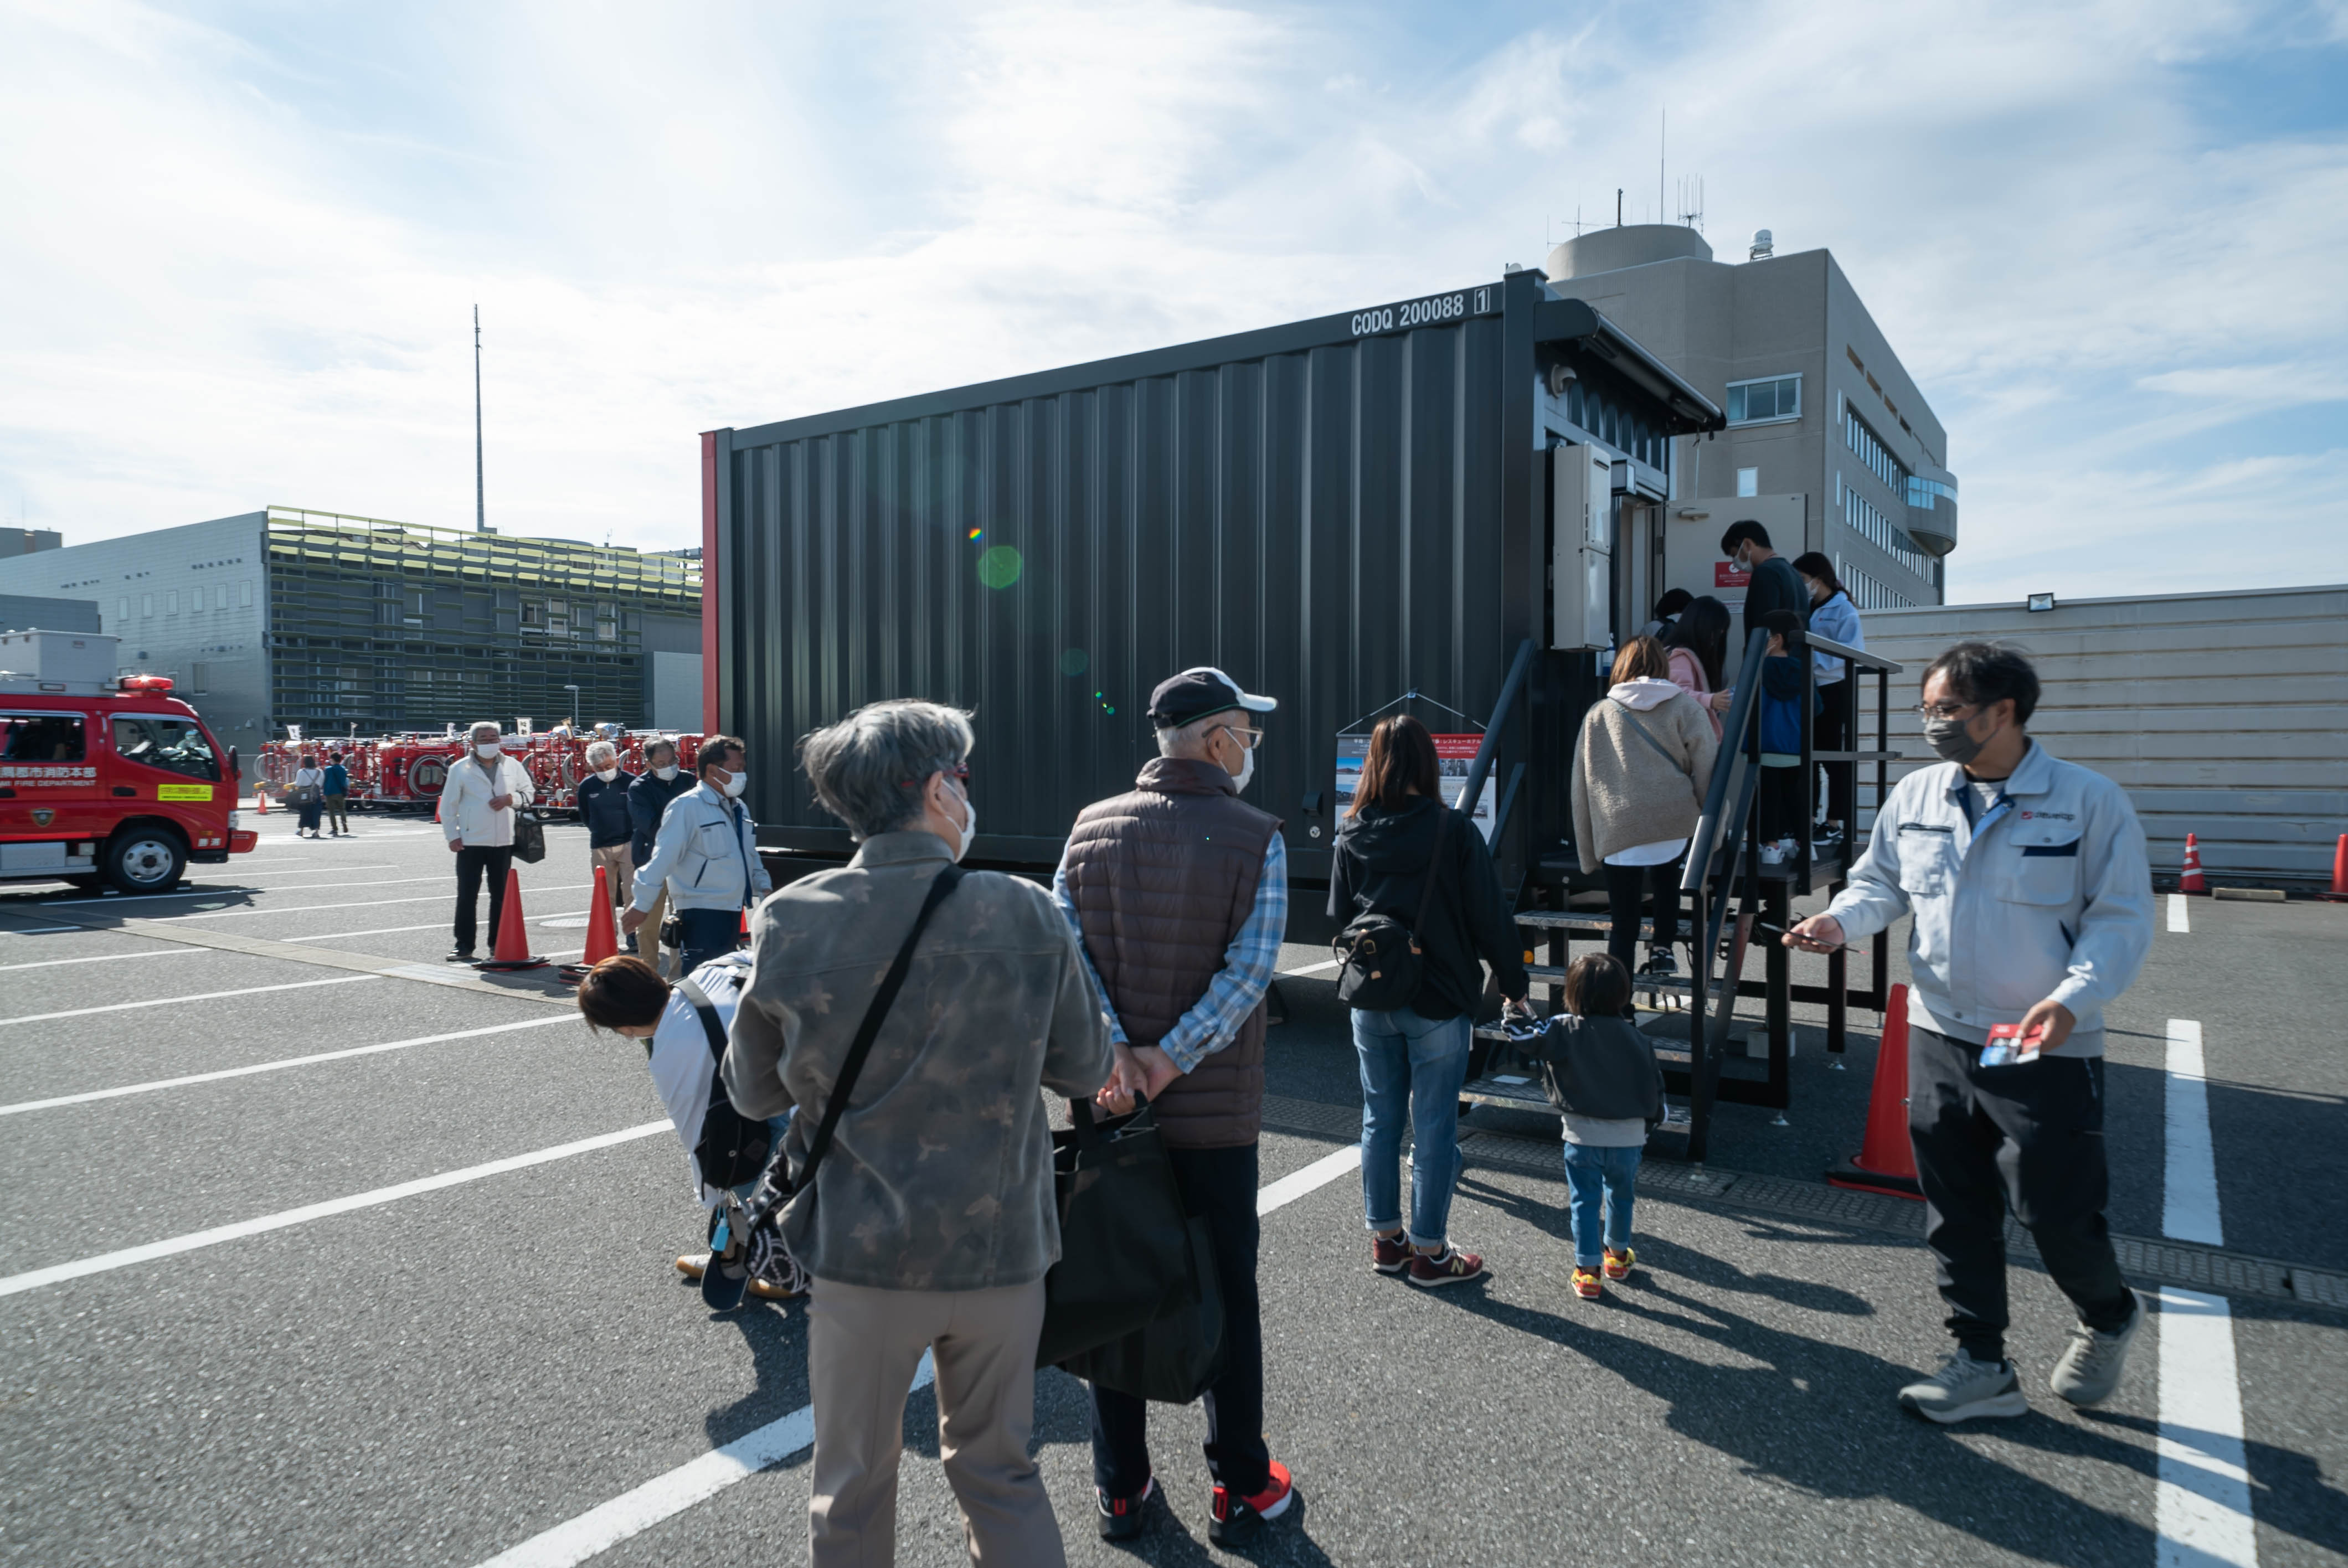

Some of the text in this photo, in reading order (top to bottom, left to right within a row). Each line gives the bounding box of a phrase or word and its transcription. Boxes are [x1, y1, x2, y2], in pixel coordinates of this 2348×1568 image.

[1352, 288, 1487, 336] CODQ 200088 1
